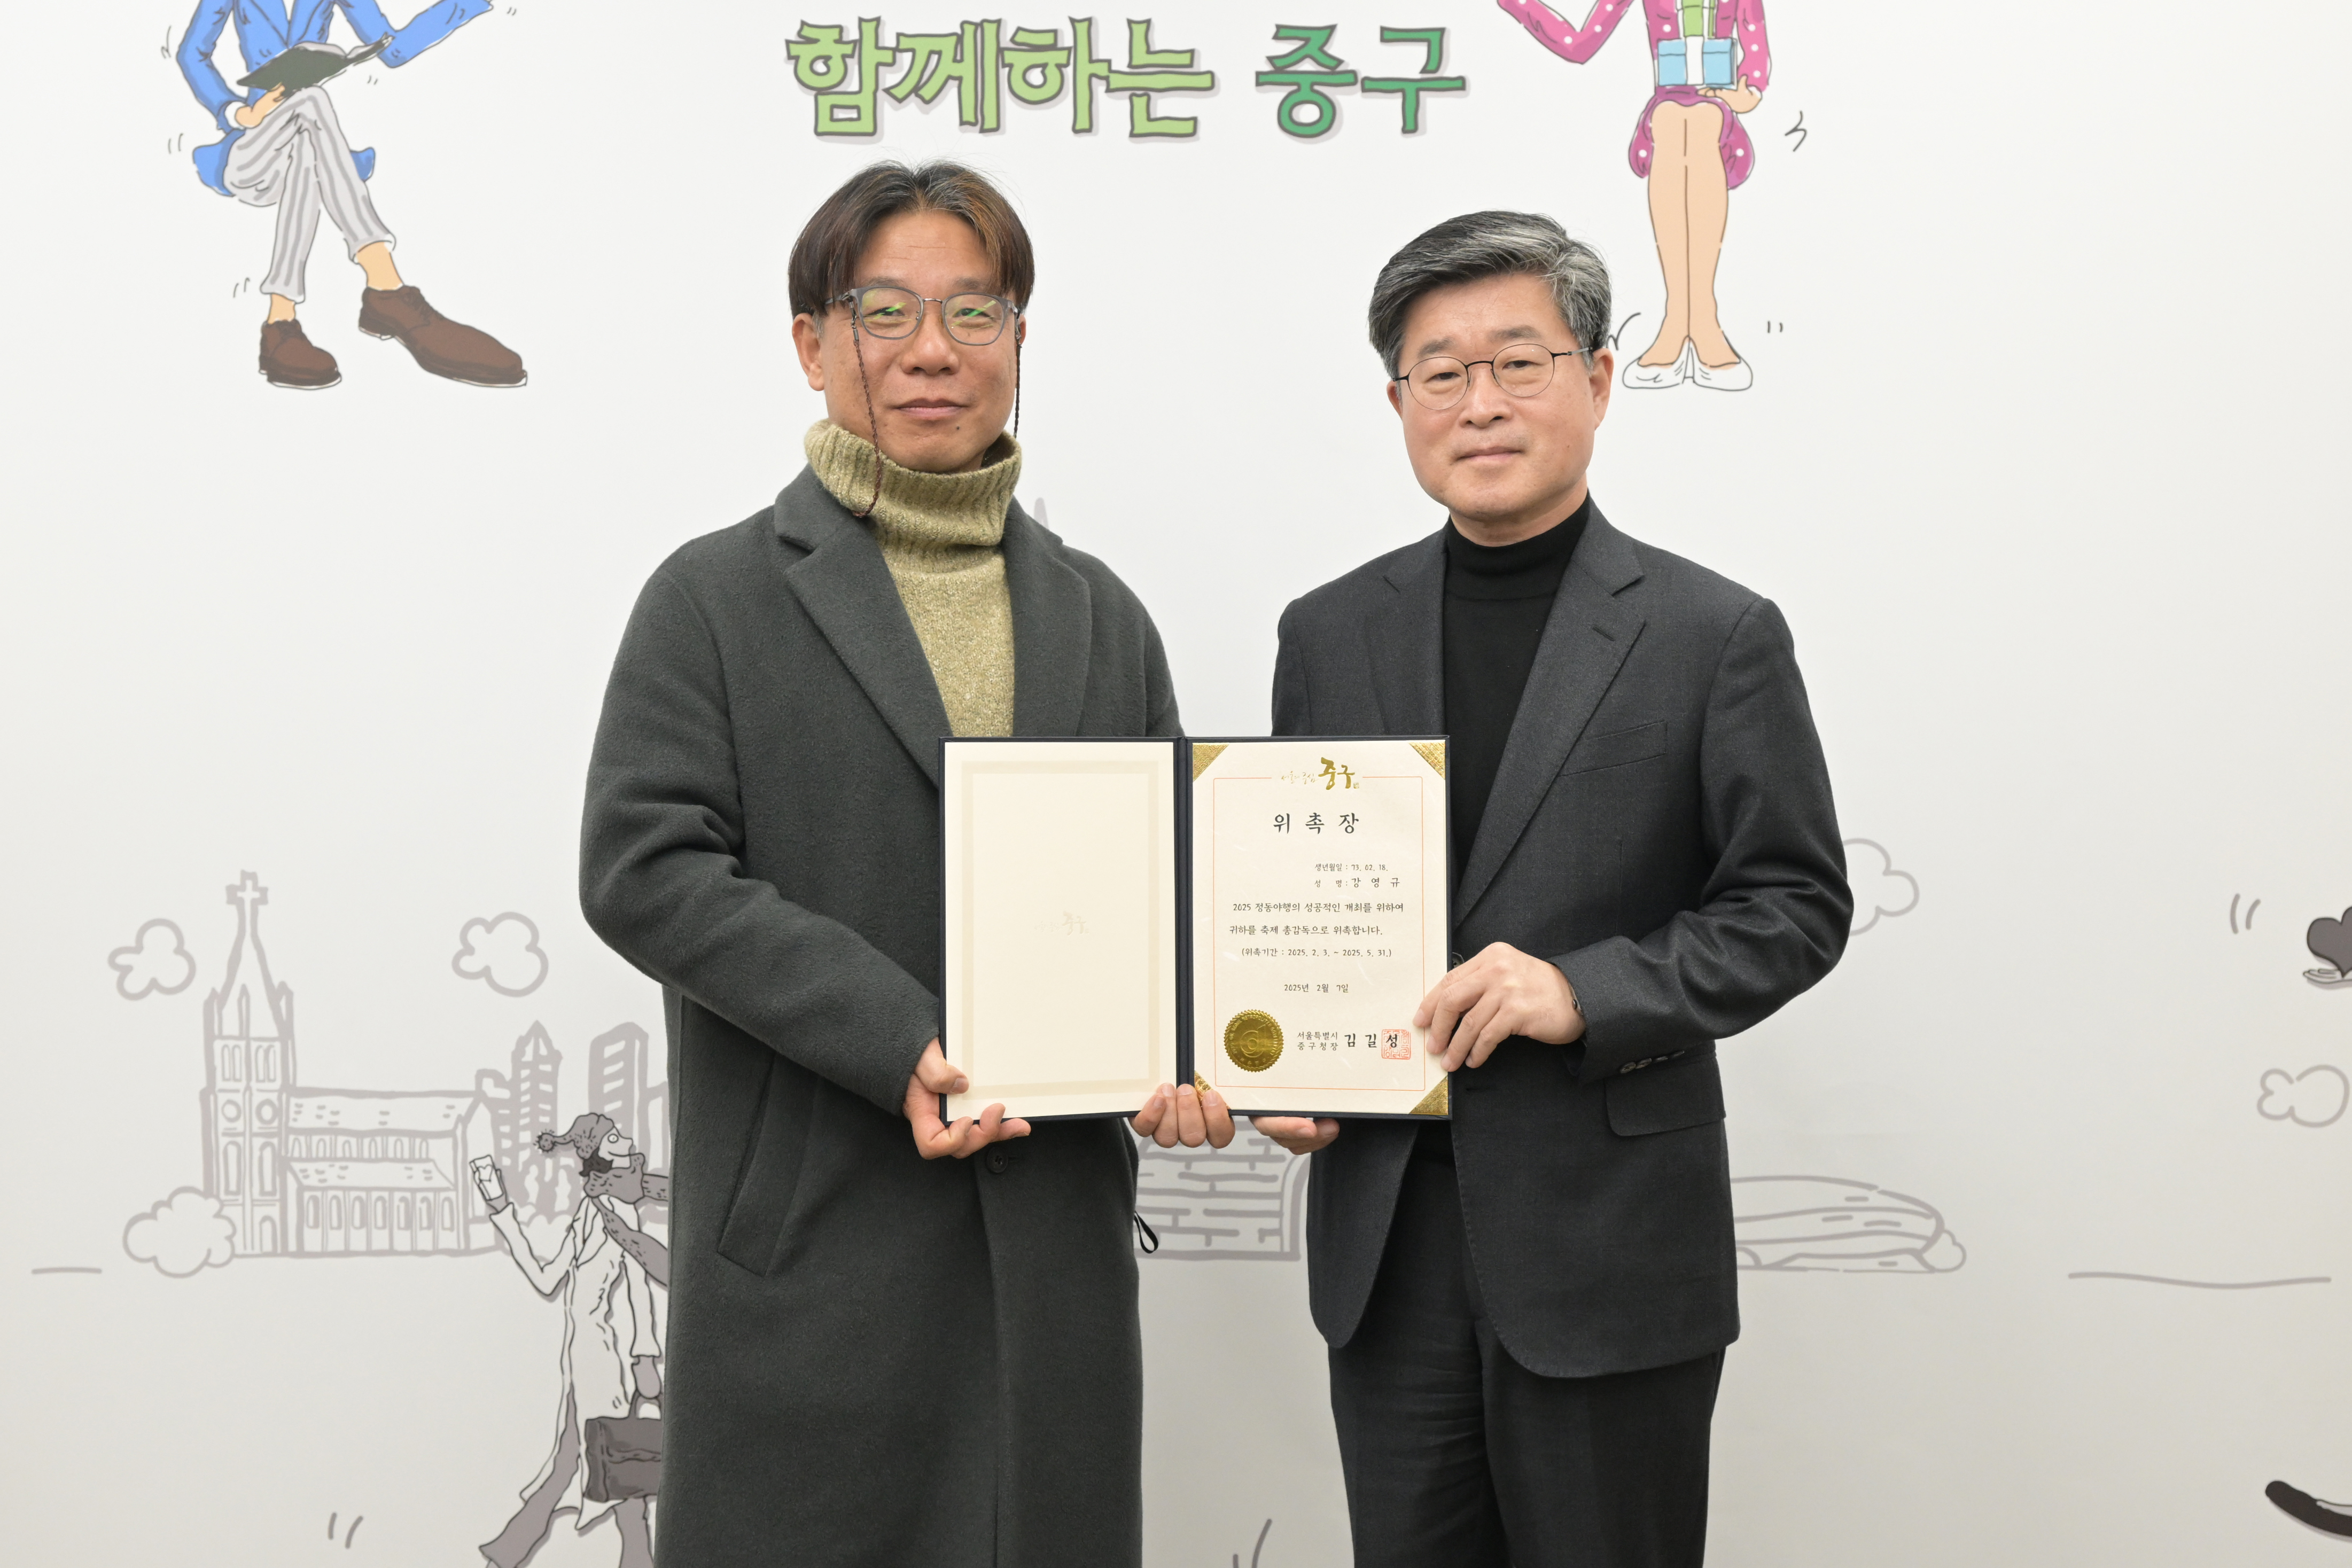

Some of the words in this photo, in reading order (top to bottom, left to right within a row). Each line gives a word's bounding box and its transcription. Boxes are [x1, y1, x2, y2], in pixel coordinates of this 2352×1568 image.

[786, 17, 1216, 138] 함께하는
[1255, 24, 1466, 138] 중구
[1318, 756, 1355, 790] 중구
[1314, 863, 1342, 872] 생년월일
[1255, 902, 1300, 912] 정동야행의
[1304, 902, 1341, 912] 성공적인
[1344, 902, 1373, 913] 개최를
[1376, 902, 1404, 912] 위하여
[1229, 925, 1257, 935] 귀하를
[1260, 925, 1279, 935] 축제
[1282, 925, 1329, 935] 총감독으로
[1333, 925, 1383, 935] 위촉합니다.
[1242, 947, 1278, 957] (위촉기간
[1288, 949, 1308, 957] 2025.
[1312, 949, 1319, 957] 2.
[1323, 949, 1330, 957] 3.
[1342, 949, 1363, 957] 2025.
[1367, 949, 1374, 957] 5.
[1377, 949, 1392, 957] 31.)
[1284, 983, 1309, 993] 2025년
[1317, 984, 1329, 993] 2월
[1336, 984, 1349, 993] 7일
[1297, 1031, 1338, 1041] 서울특별시
